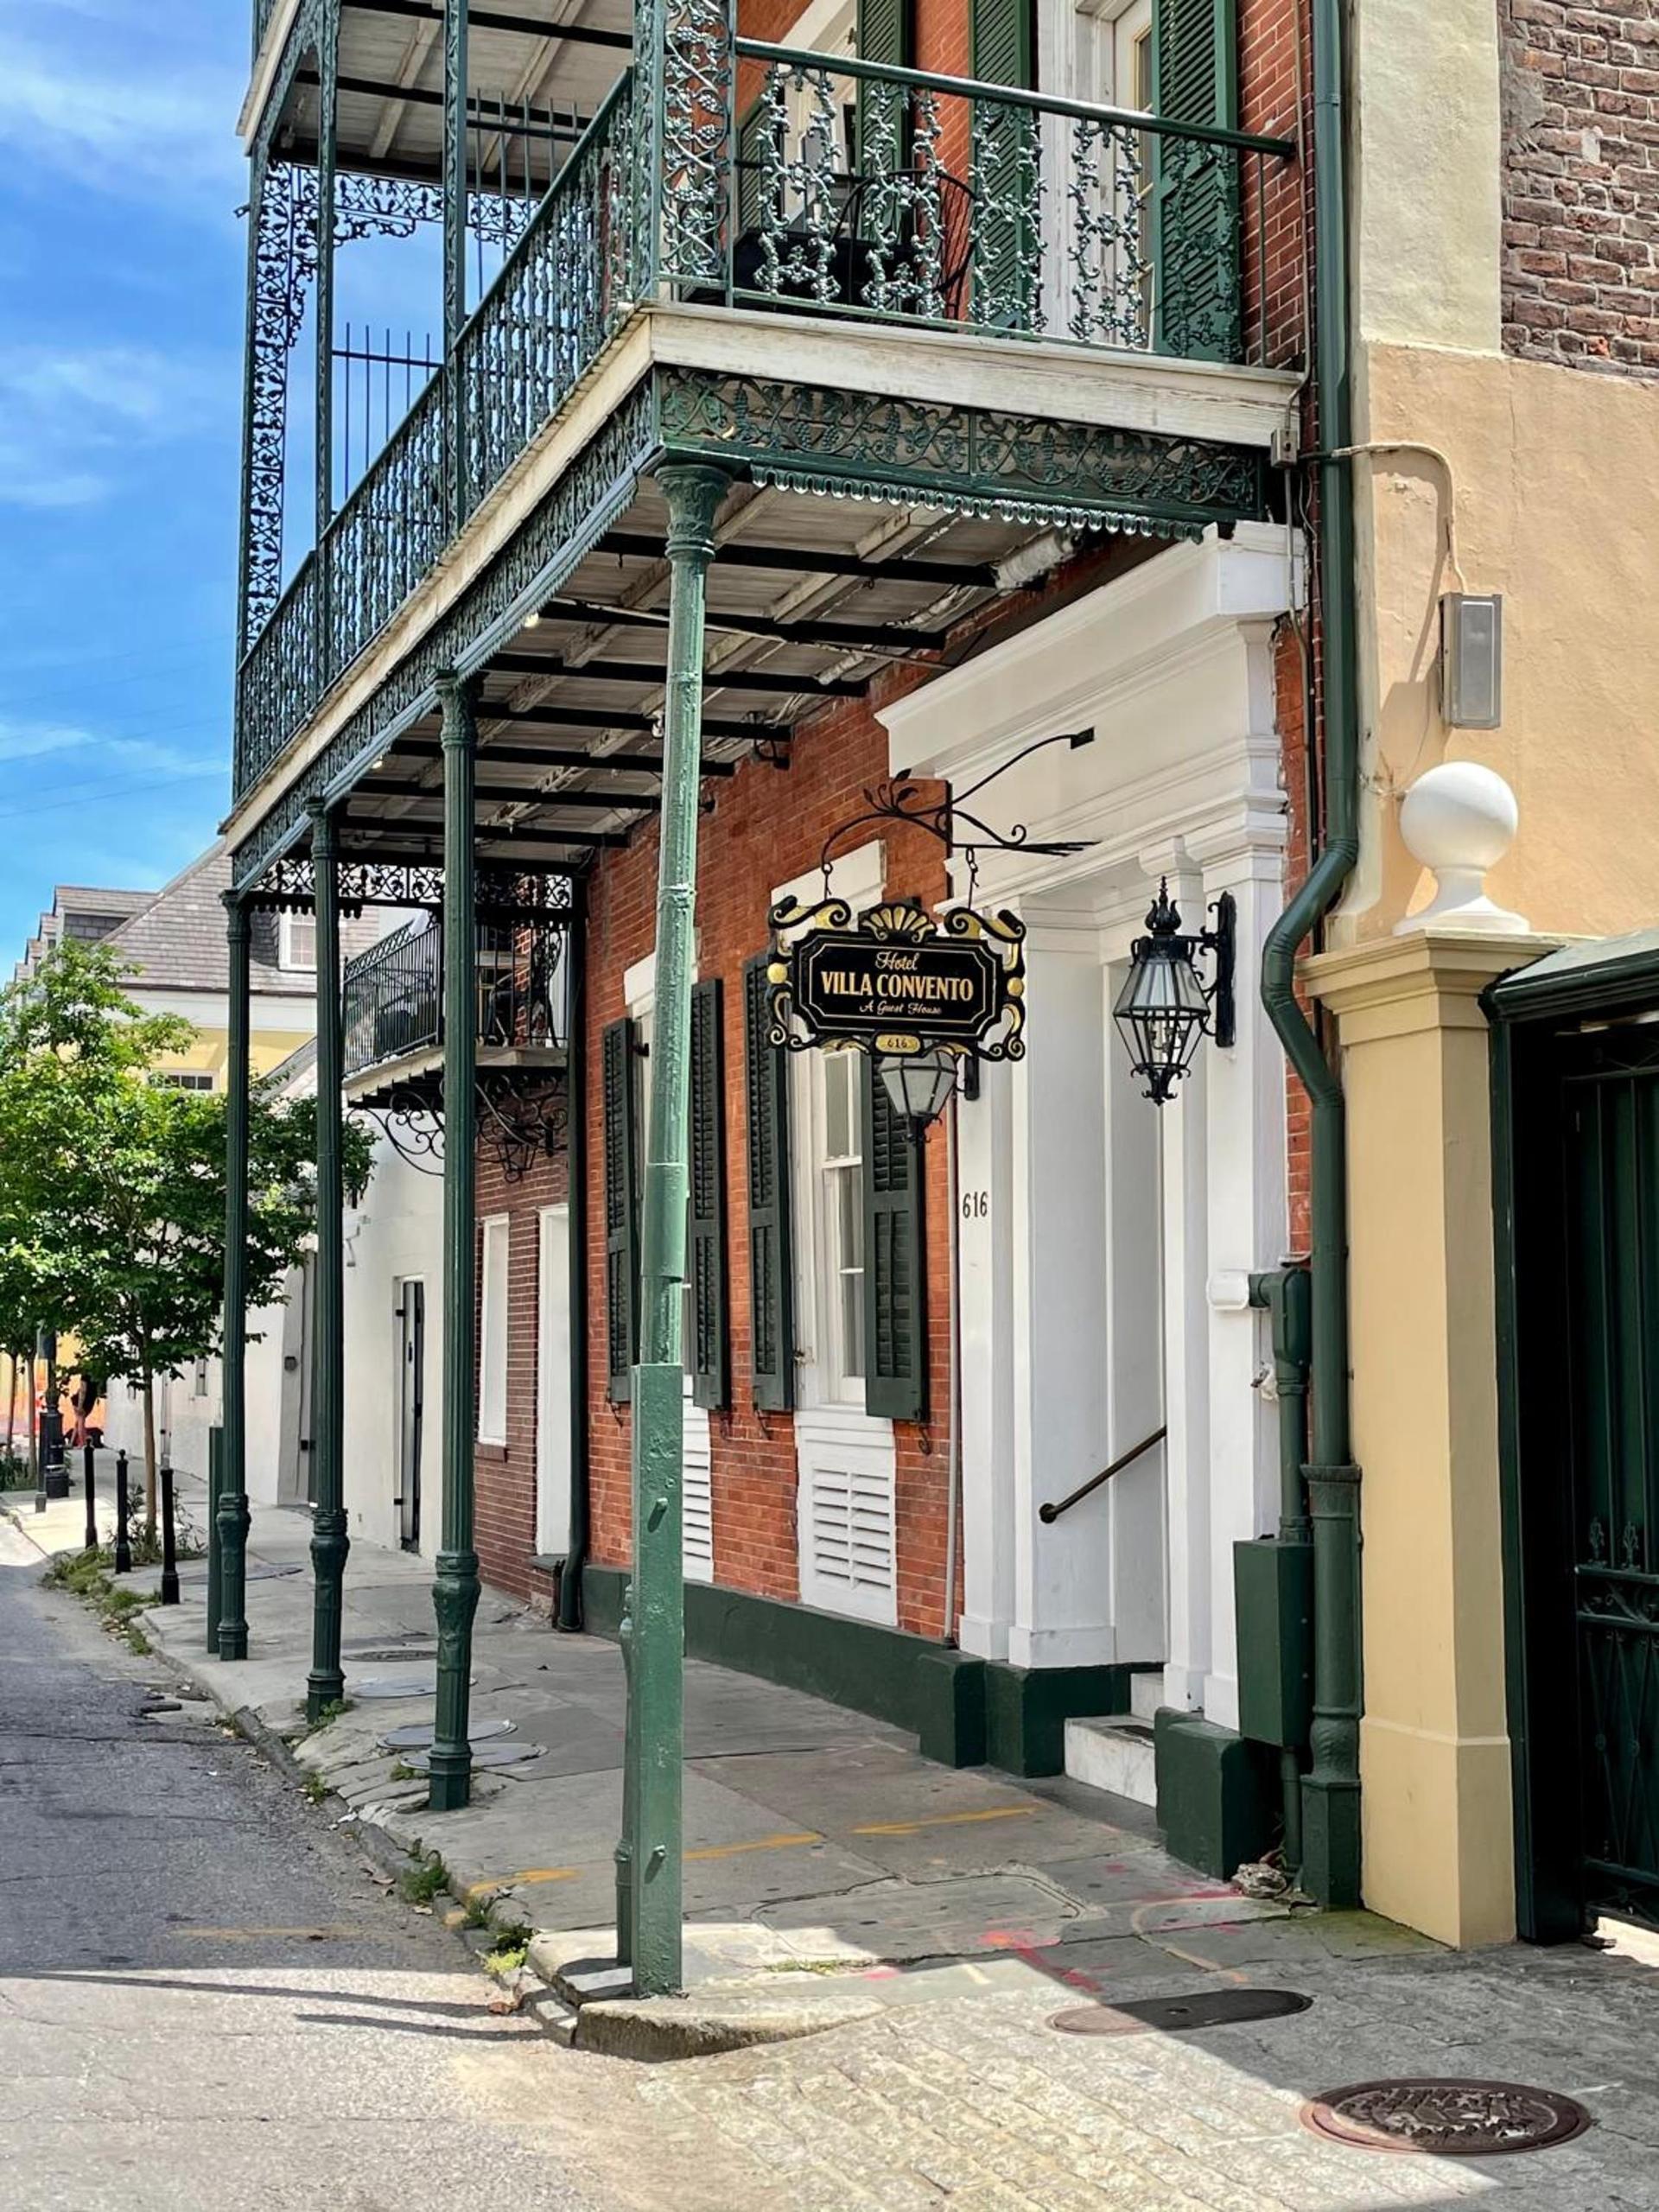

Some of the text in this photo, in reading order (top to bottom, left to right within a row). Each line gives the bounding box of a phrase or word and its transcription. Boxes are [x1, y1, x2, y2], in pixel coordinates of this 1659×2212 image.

[874, 951, 918, 971] Hotel
[821, 971, 974, 1001] VILLA CONVENTO
[859, 1000, 942, 1014] A Guest House
[887, 1037, 908, 1048] 616
[963, 1191, 988, 1218] 616
